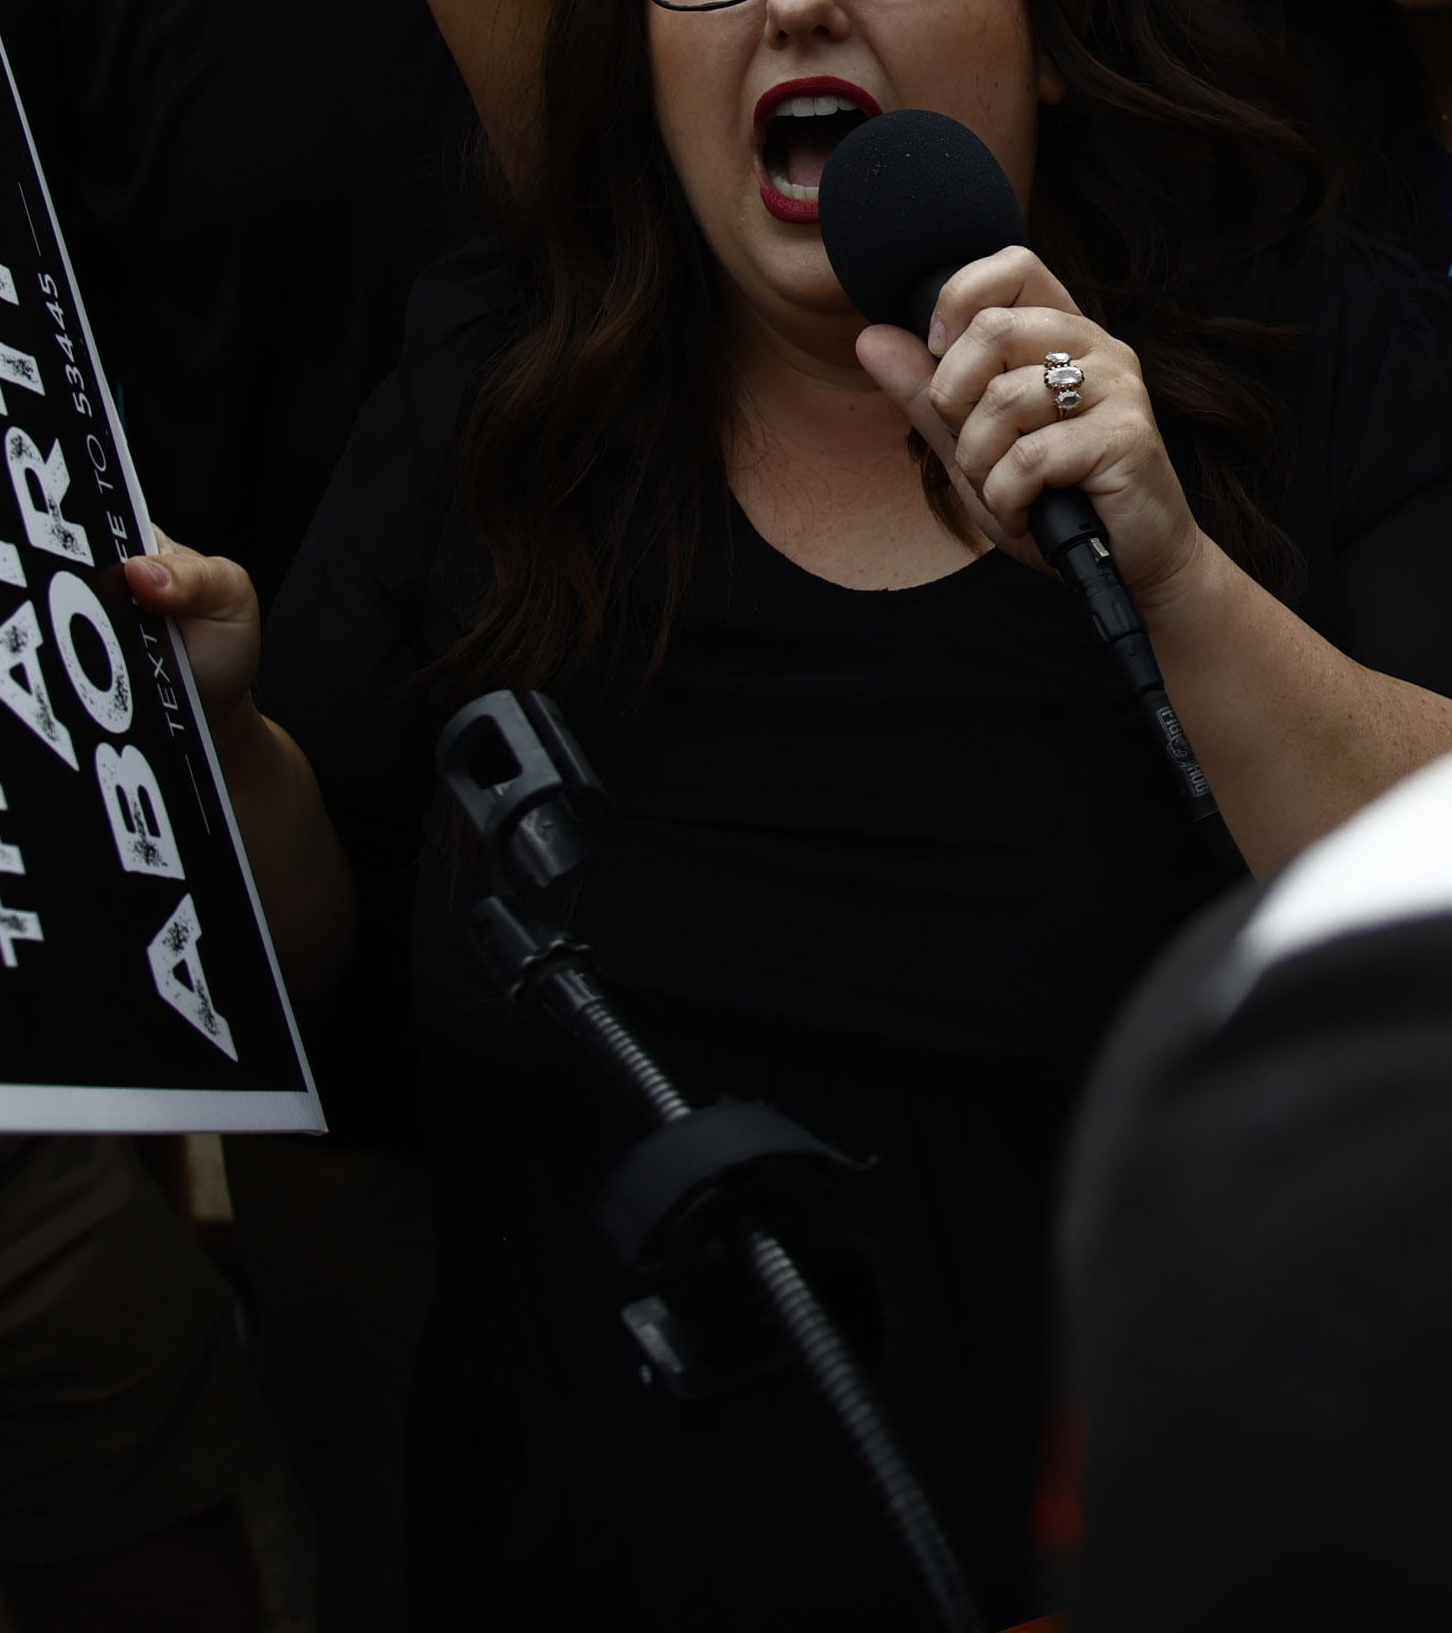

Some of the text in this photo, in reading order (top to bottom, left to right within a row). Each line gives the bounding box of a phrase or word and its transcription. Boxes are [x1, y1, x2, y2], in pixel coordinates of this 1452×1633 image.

[37, 272, 93, 419] 53445
[86, 433, 114, 494] TO
[139, 620, 186, 737] TEXT
